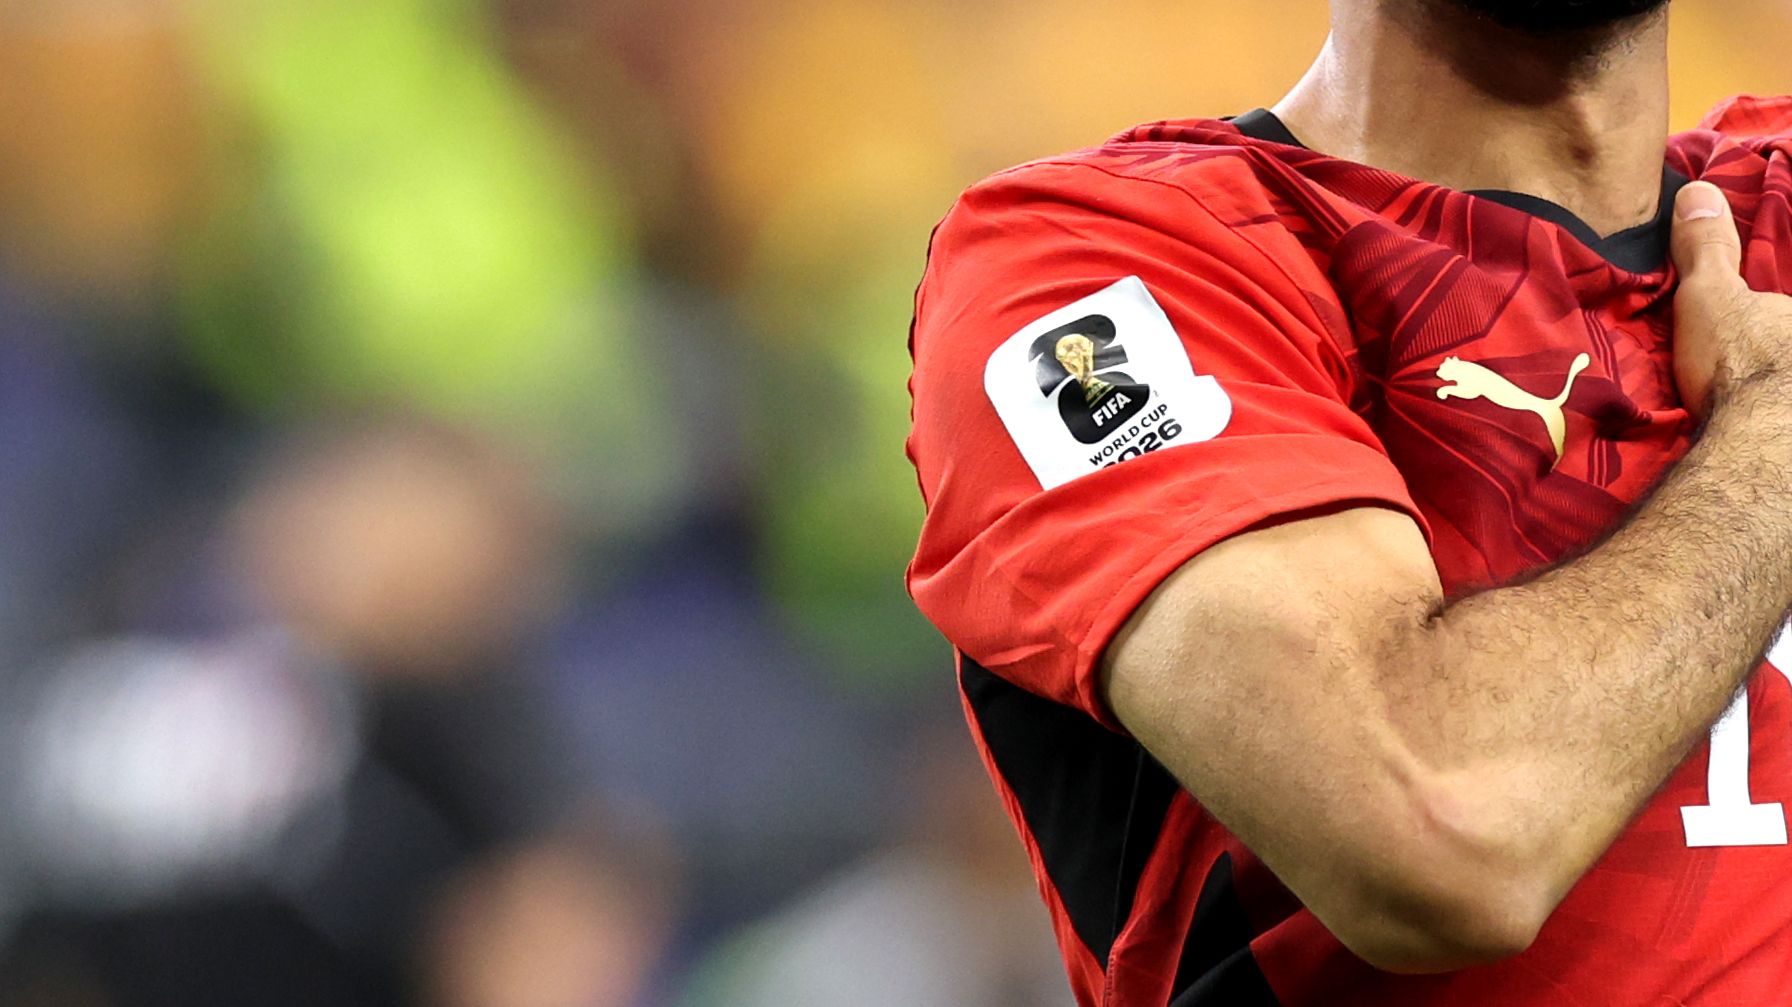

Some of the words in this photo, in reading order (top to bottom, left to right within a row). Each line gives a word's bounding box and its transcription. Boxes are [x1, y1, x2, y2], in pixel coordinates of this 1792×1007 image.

[1089, 425, 1140, 466] WORLD
[1141, 403, 1168, 428] CUP
[1092, 392, 1132, 427] FIFA
[1103, 418, 1182, 468] 026
